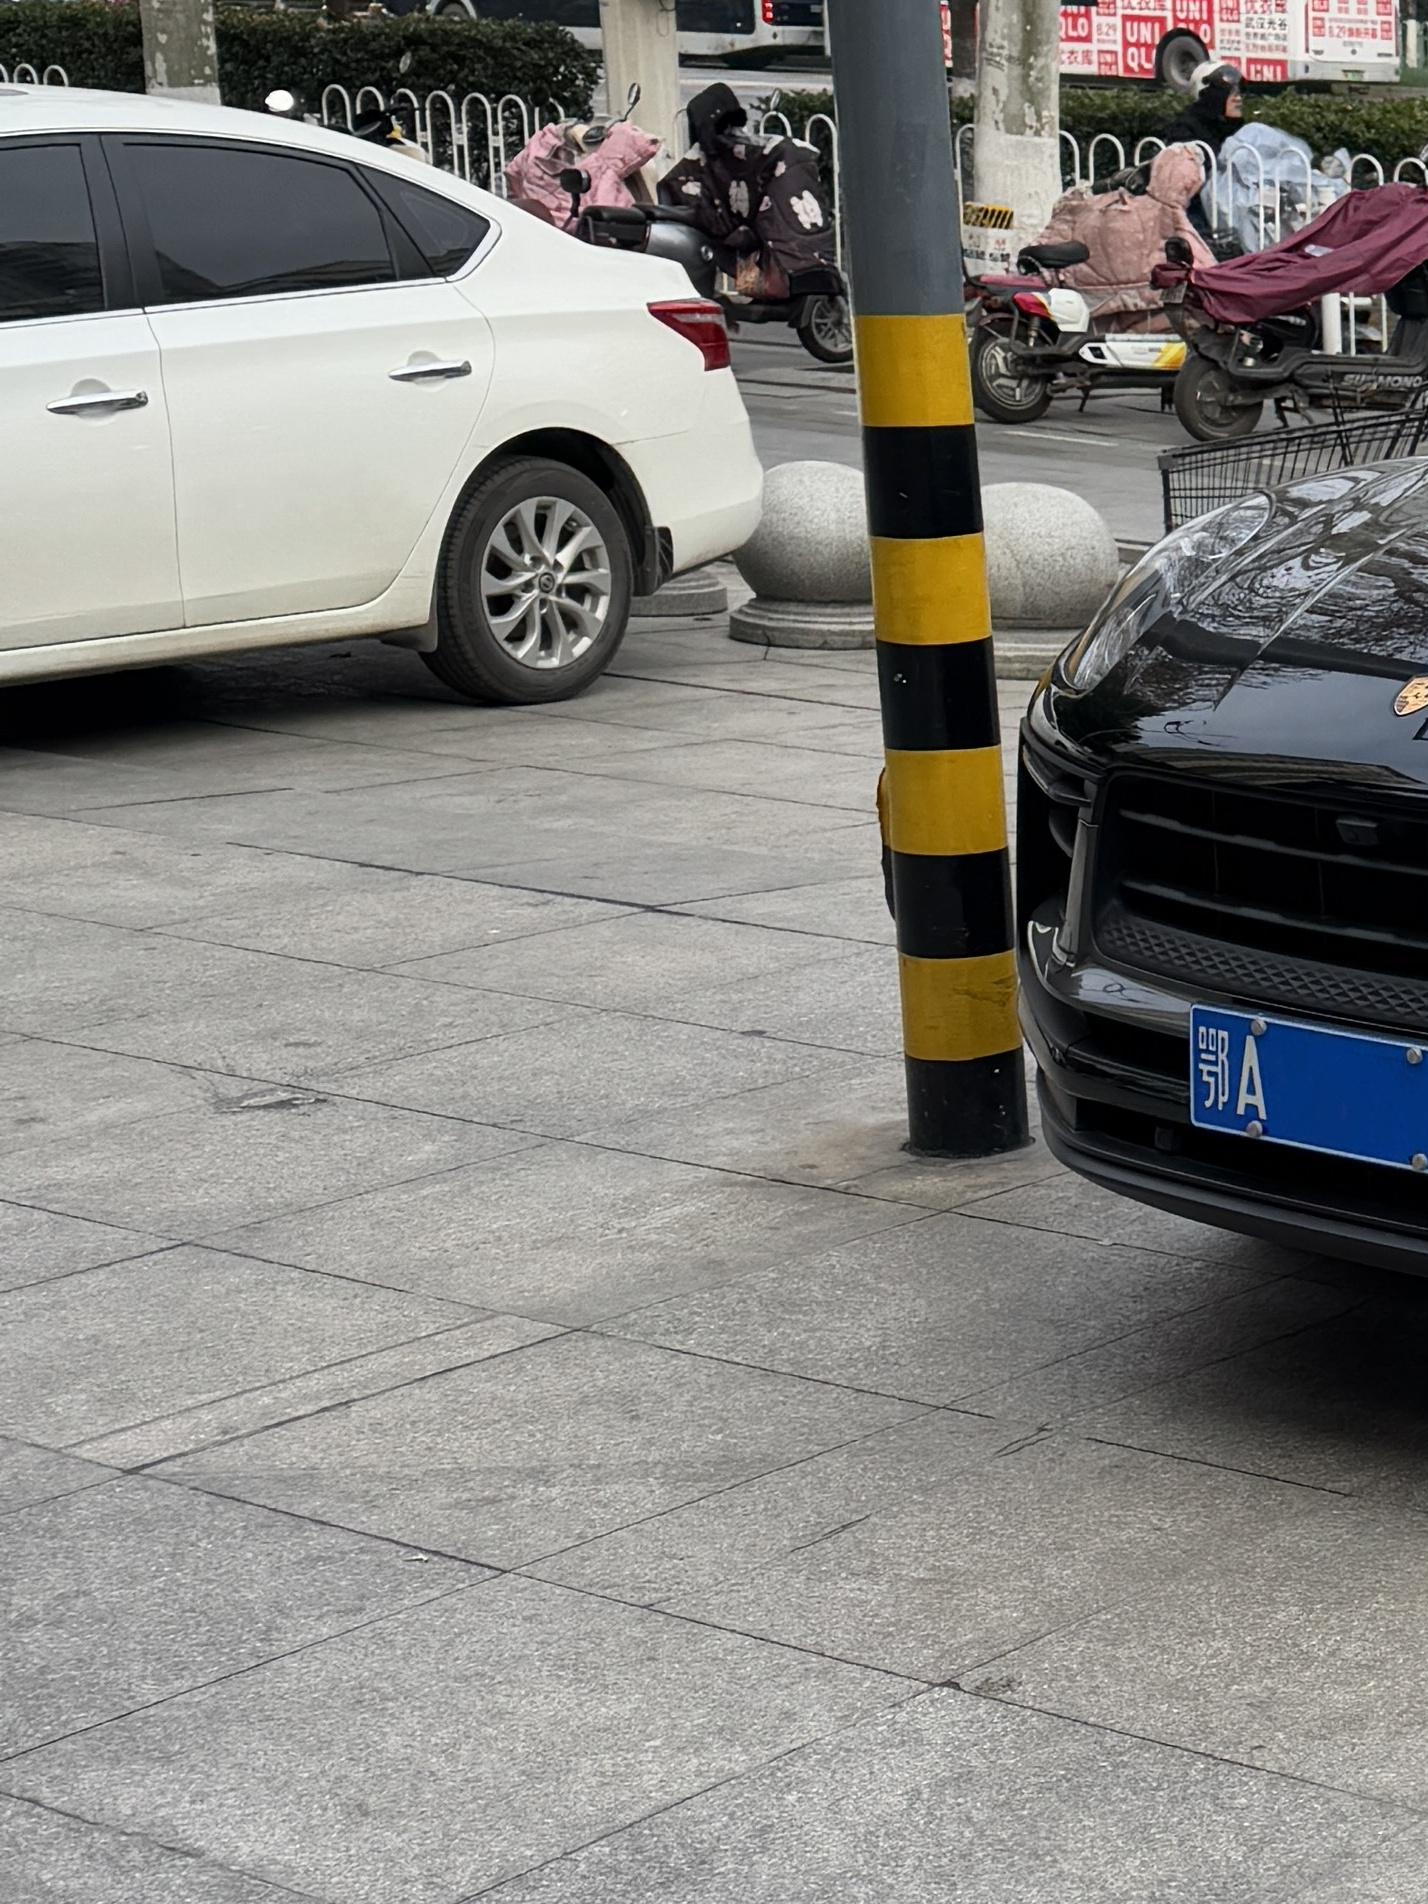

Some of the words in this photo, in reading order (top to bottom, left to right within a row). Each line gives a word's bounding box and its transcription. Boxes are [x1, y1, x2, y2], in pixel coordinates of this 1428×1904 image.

[1176, 0, 1208, 19] UNI
[1126, 21, 1161, 45] UNI
[1341, 373, 1423, 388] SUMONO
[1198, 1026, 1268, 1121] 鄂A
